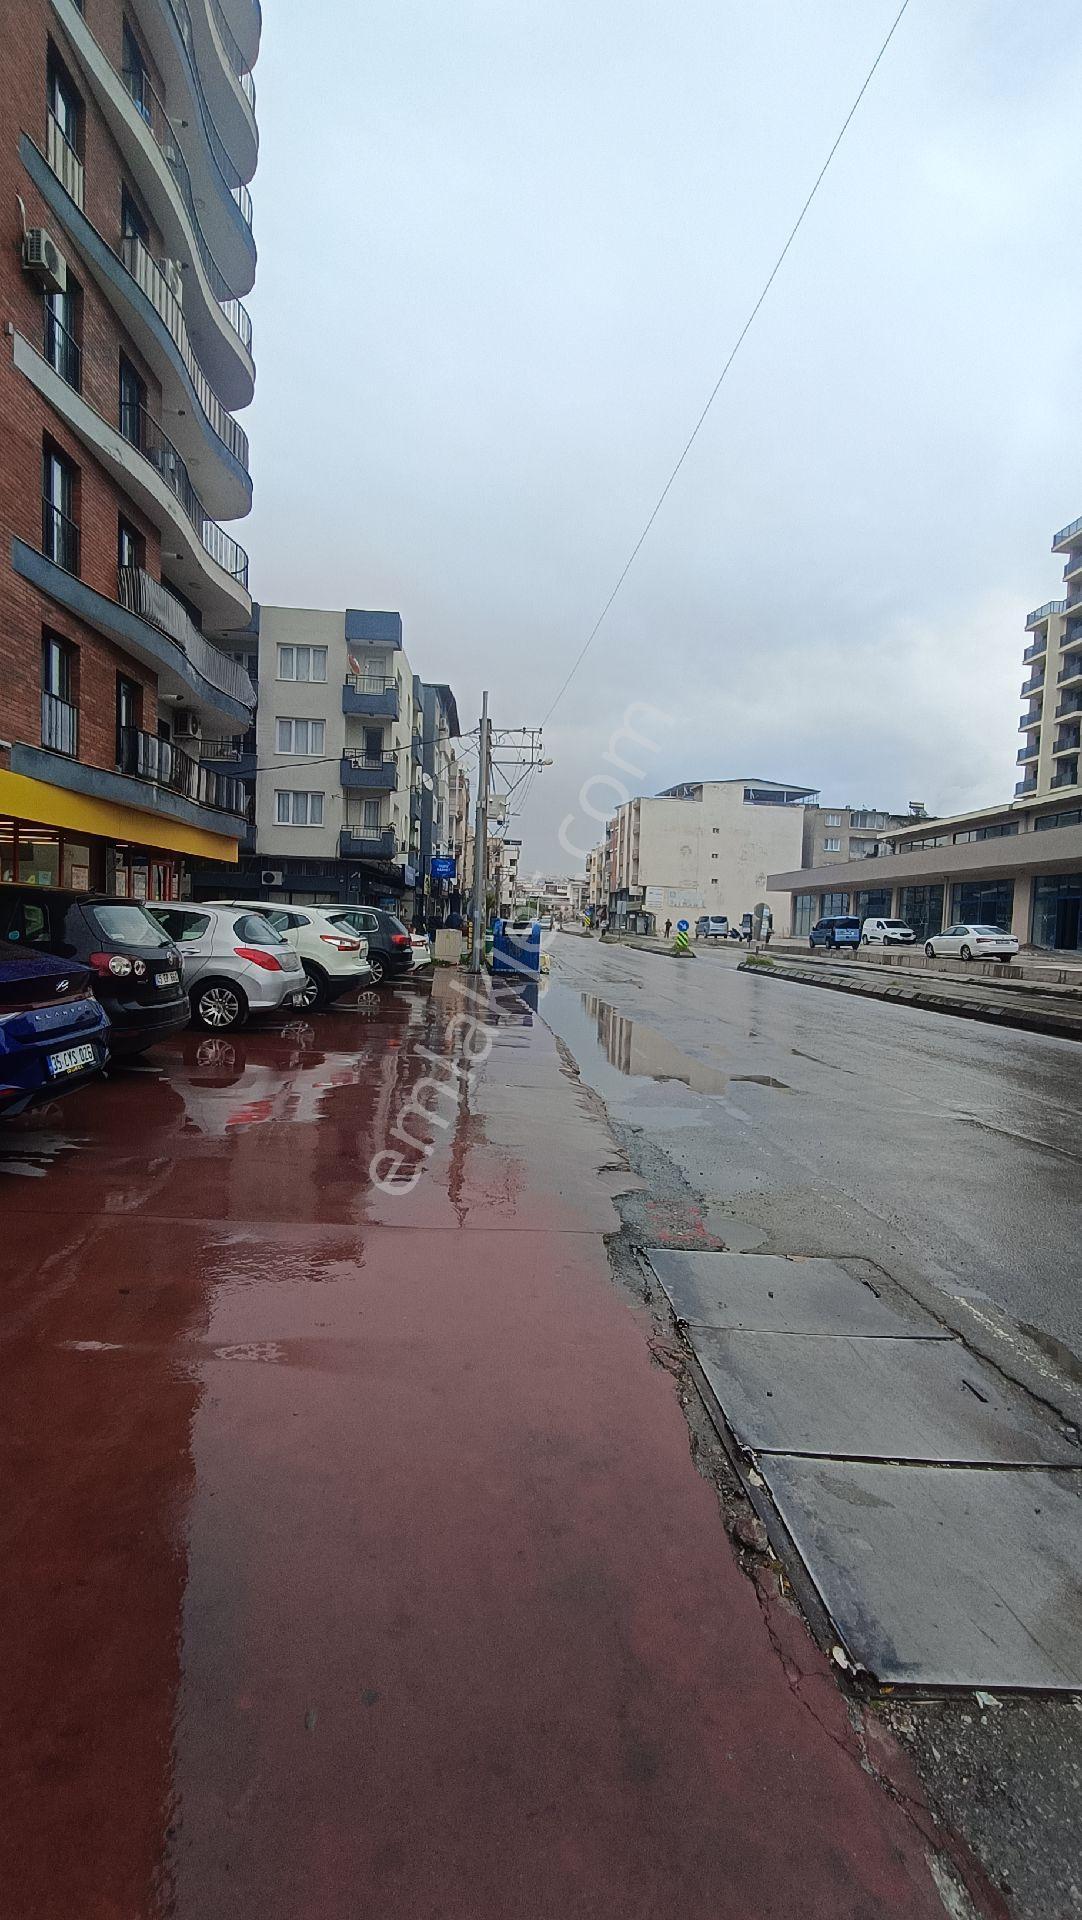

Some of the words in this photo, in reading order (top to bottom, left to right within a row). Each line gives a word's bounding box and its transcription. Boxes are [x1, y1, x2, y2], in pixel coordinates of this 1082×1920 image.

[51, 1054, 63, 1072] 35
[63, 1050, 78, 1067] CYS
[78, 1045, 93, 1062] 026
